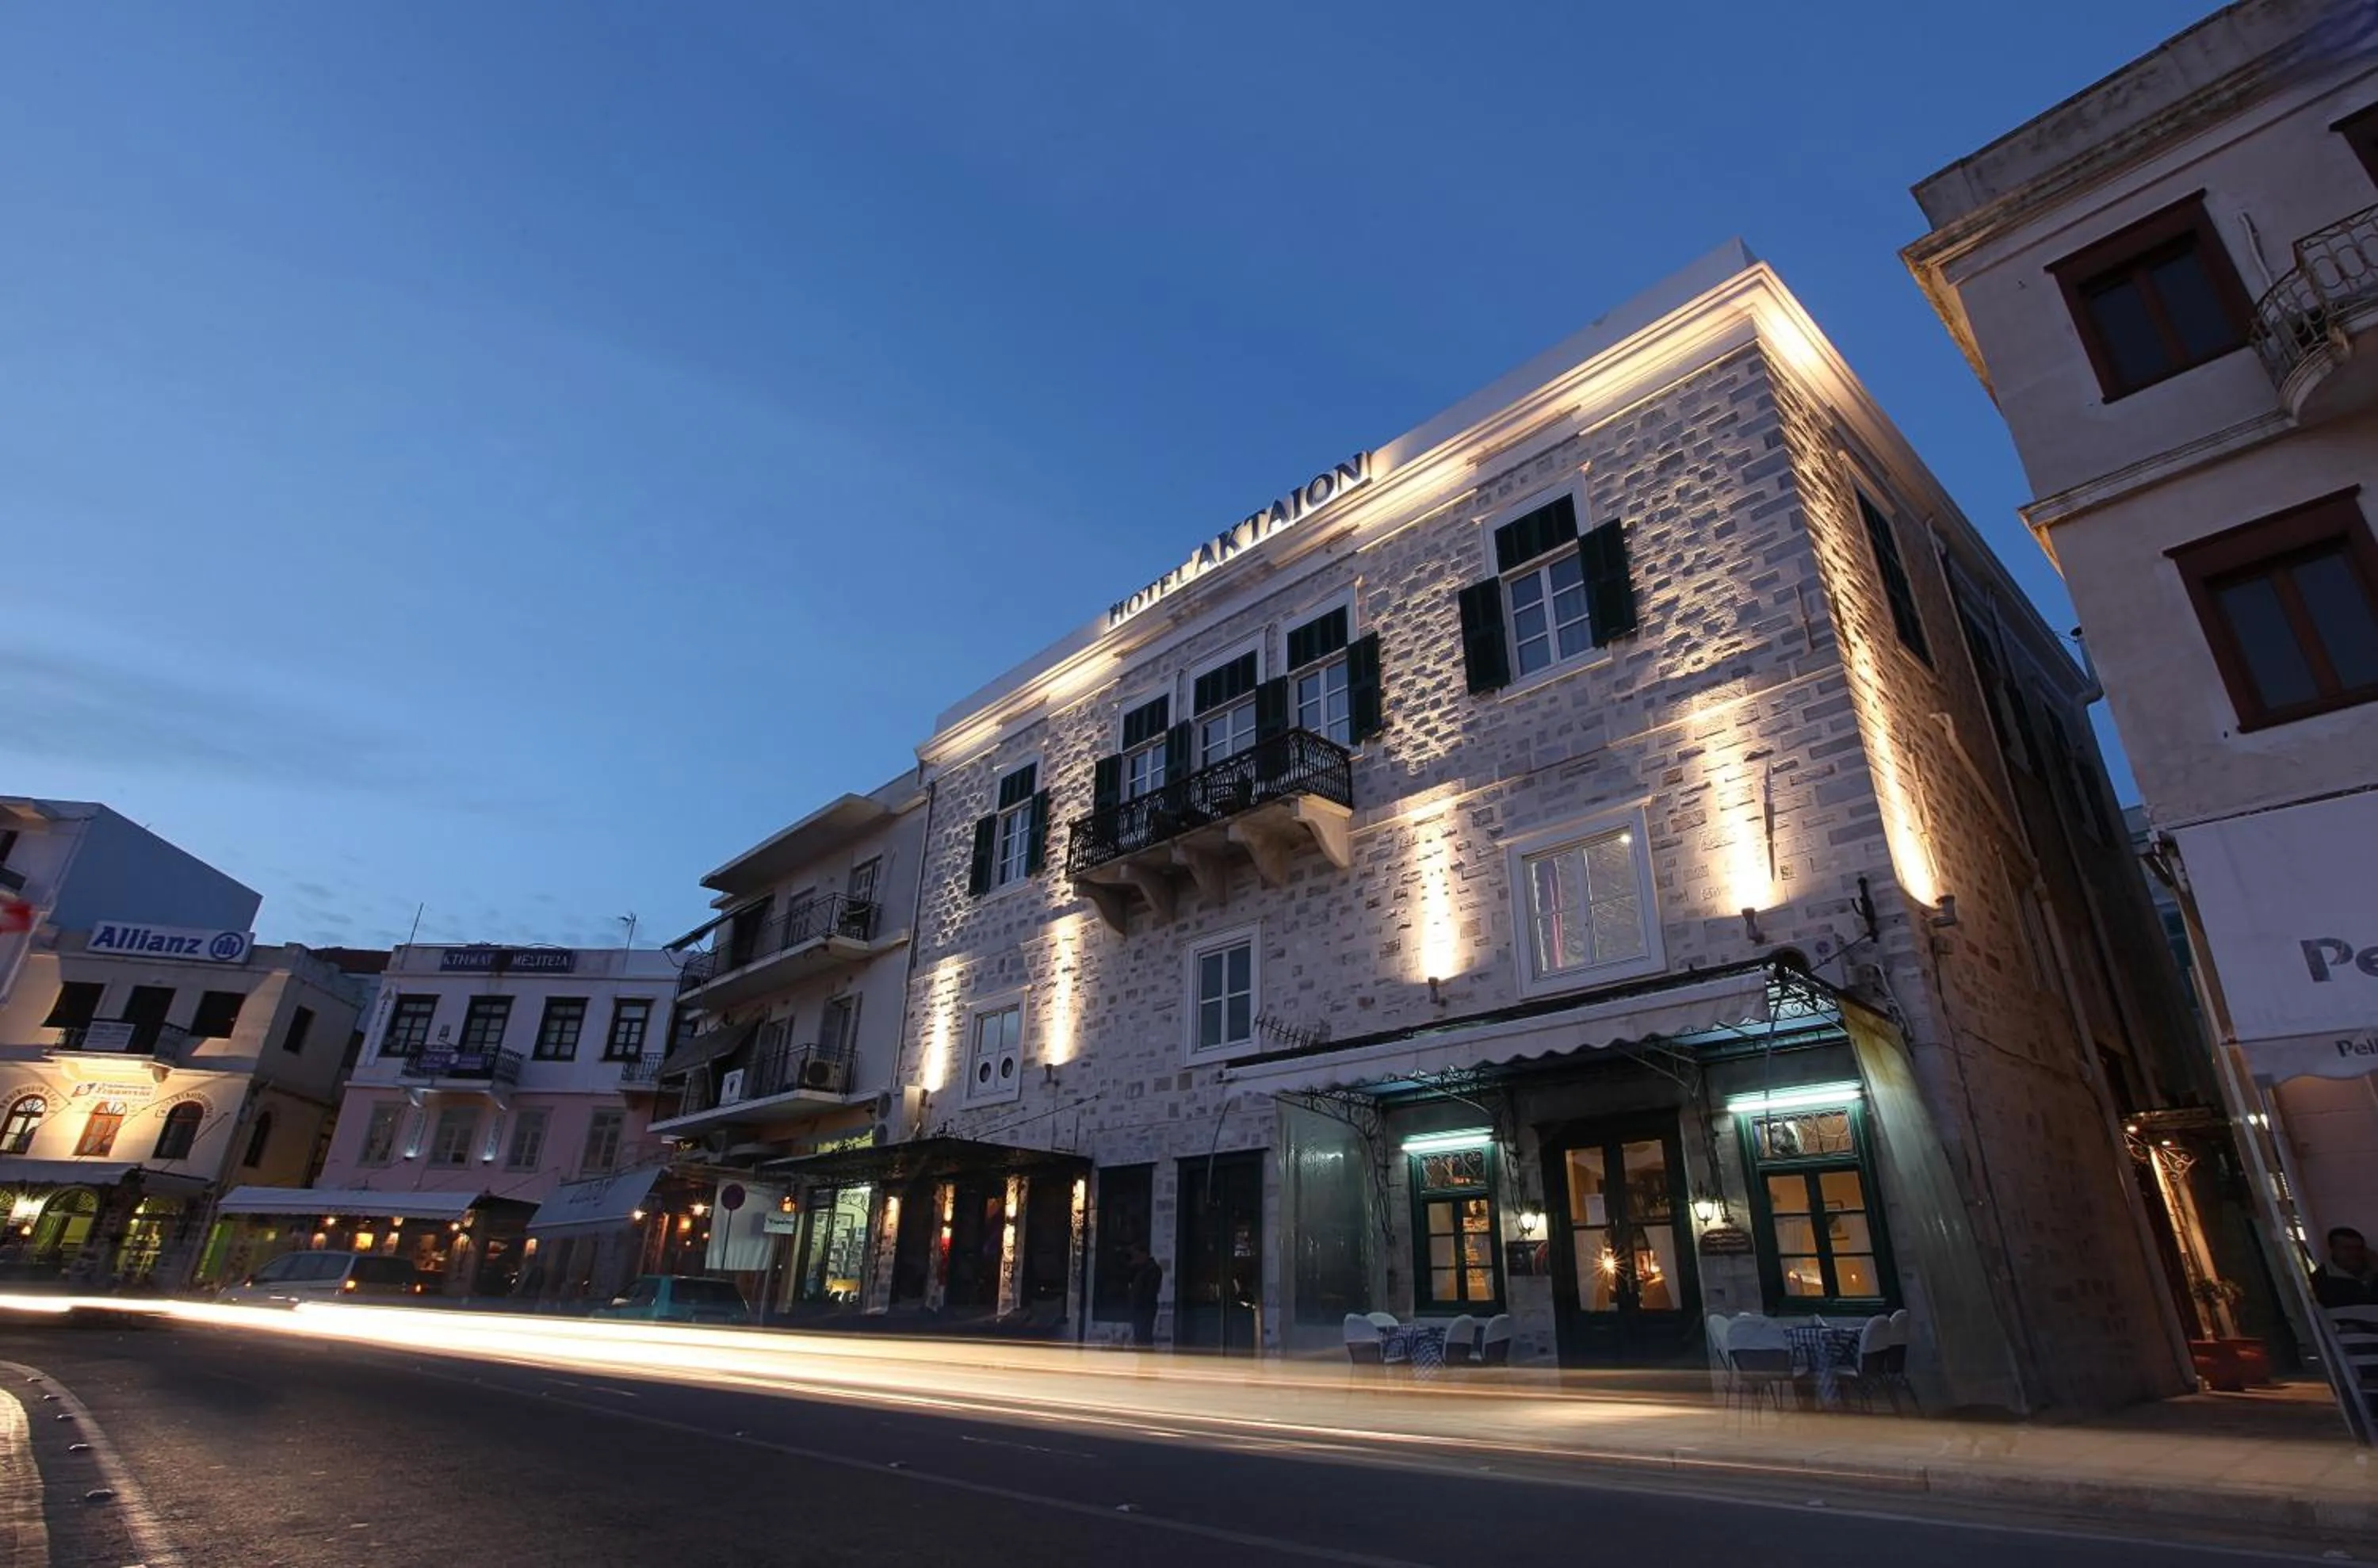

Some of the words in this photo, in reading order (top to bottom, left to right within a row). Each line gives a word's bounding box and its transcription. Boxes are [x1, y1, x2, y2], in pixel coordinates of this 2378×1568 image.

[1109, 562, 1193, 625] HOTEL
[1196, 450, 1372, 573] AKTAION
[93, 925, 203, 954] Allianz
